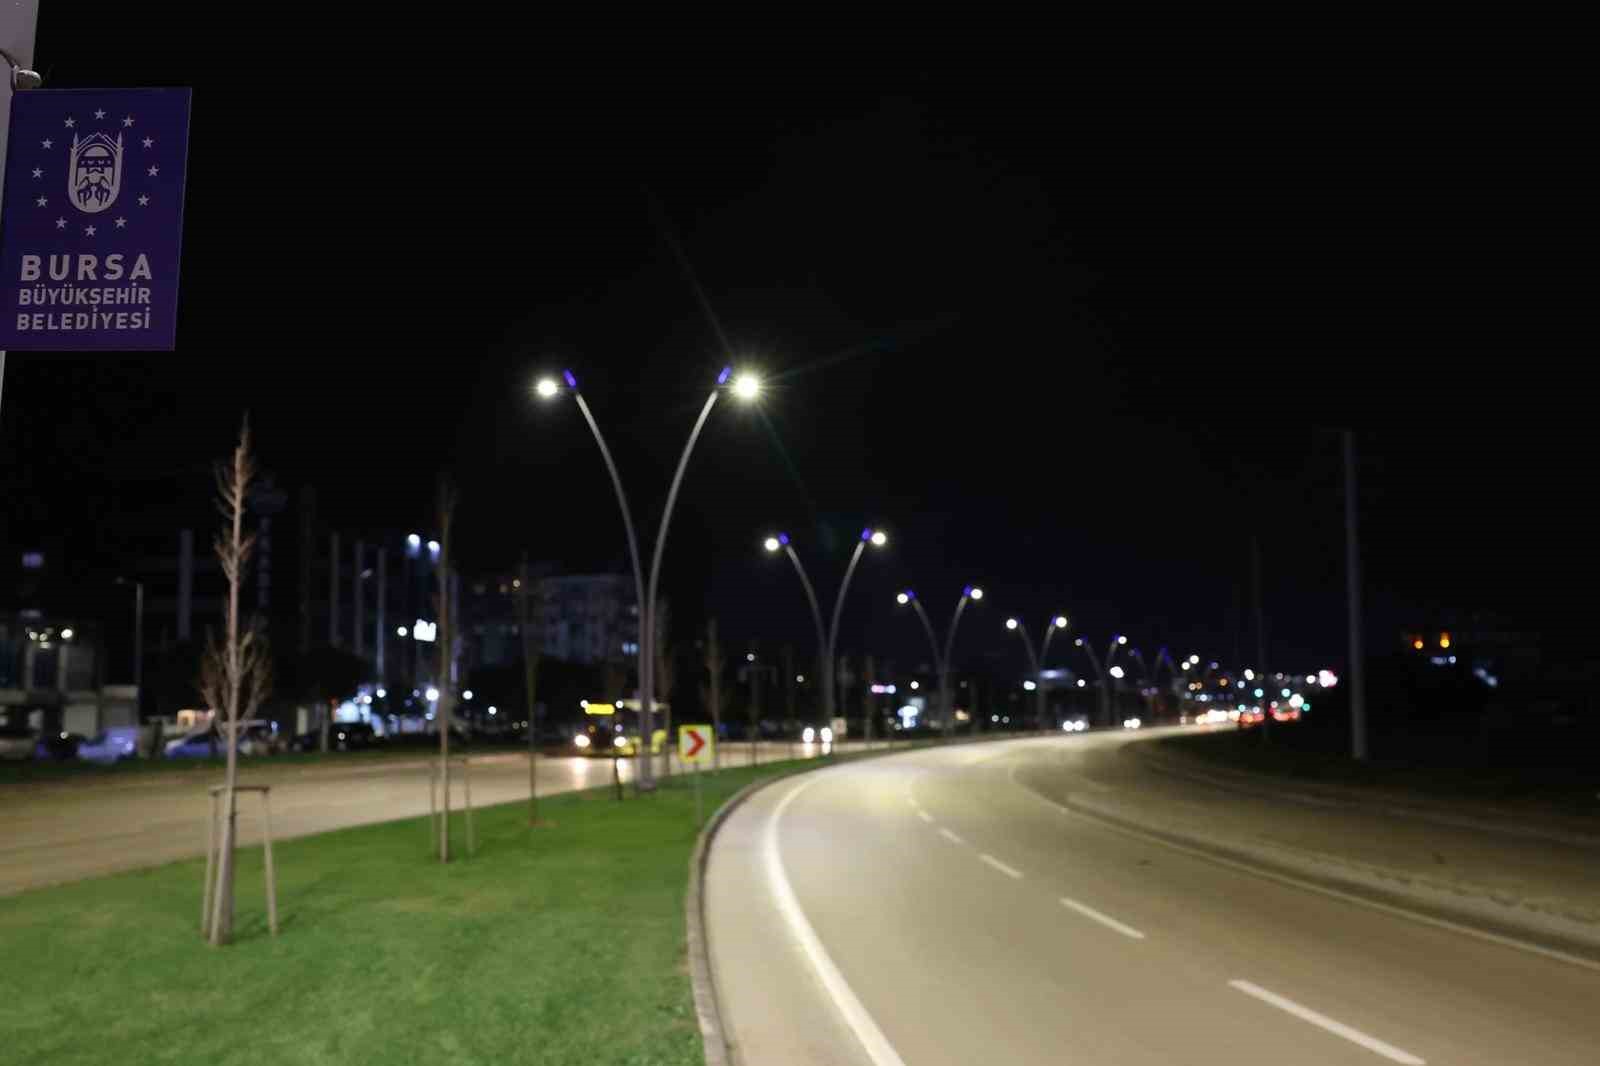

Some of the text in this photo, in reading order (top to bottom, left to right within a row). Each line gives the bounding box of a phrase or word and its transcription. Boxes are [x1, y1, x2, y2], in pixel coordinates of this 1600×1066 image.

[20, 253, 152, 281] BURSA
[18, 283, 151, 308] BÜYÜKŞEHİR
[16, 307, 151, 331] BELEDİYESİ
